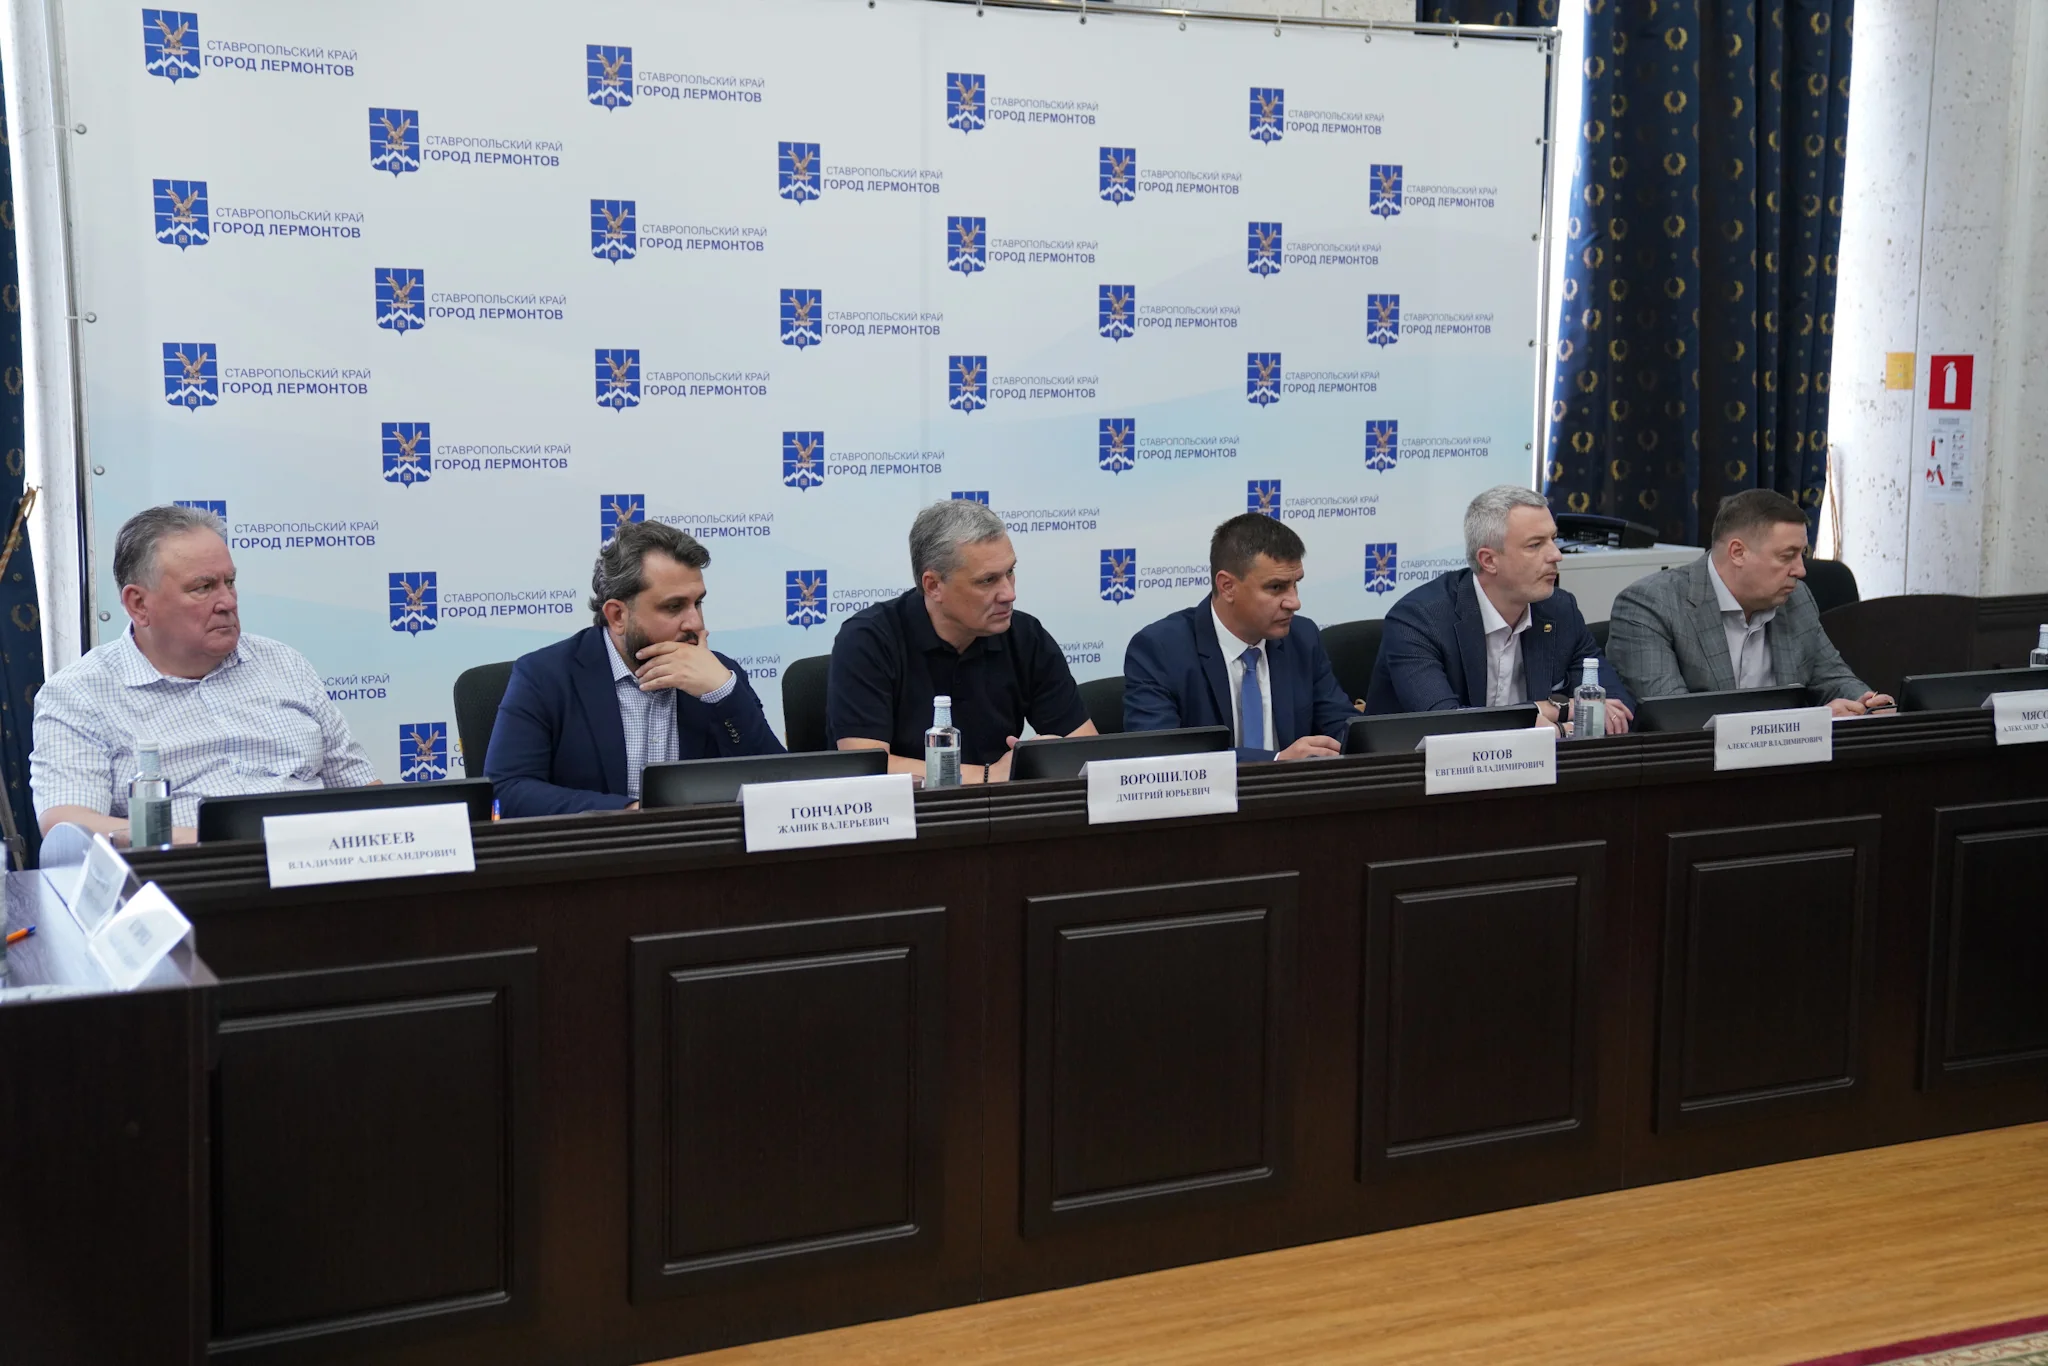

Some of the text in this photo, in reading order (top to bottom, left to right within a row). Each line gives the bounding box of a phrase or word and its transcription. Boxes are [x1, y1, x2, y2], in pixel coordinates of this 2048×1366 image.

[206, 40, 358, 60] СТАВРОПОЛЬСКИЙ КРАЙ
[204, 55, 354, 77] ГОРОД ЛЕРМОНТОВ
[638, 72, 765, 88] СТАВРОПОЛЬСКИЙ КРАЙ
[636, 85, 762, 102] ГОРОД ЛЕРМОНТОВ
[990, 97, 1099, 112] СТАВРОПОЛЬСКИЙ КРАЙ
[988, 109, 1096, 125] ГОРОД ЛЕРМОНТОВ
[1288, 110, 1385, 123] СТАВРОПОЛЬСКИЙ КРАЙ
[1286, 121, 1382, 135] ГОРОД ЛЕРМОНТОВ
[425, 136, 563, 152] СТАВРОПОЛЬСКИЙ КРАЙ
[424, 149, 559, 166] ГОРОД ЛЕРМОНТОВ
[826, 166, 944, 180] СТАВРОПОЛЬСКИЙ КРАЙ
[1140, 170, 1242, 182] СТАВРОПОЛЬСКИЙ КРАЙ
[824, 179, 940, 193] ГОРОД ЛЕРМОНТОВ
[1138, 181, 1239, 194] ГОРОД ЛЕРМОНТОВ
[1406, 184, 1498, 196] СТАВРОПОЛЬСКИЙ КРАЙ
[1404, 196, 1494, 208] ГОРОД ЛЕРМОНТОВ
[215, 208, 365, 222] СТАВРОПОЛЬСКИЙ КРАЙ
[214, 222, 361, 238] ГОРОД ЛЕРМОНТОВ
[641, 224, 768, 237] СТАВРОПОЛЬСКИЙ КРАЙ
[640, 237, 764, 251] ГОРОД ЛЕРМОНТОВ
[990, 238, 1099, 250] СТАВРОПОЛЬСКИЙ КРАЙ
[1286, 242, 1382, 253] СТАВРОПОЛЬСКИЙ КРАЙ
[989, 251, 1095, 263] ГОРОД ЛЕРМОНТОВ
[1284, 254, 1379, 266] ГОРОД ЛЕРМОНТОВ
[431, 293, 567, 305] СТАВРОПОЛЬСКИЙ КРАЙ
[429, 307, 563, 320] ГОРОД ЛЕРМОНТОВ
[827, 311, 944, 322] СТАВРОПОЛЬСКИЙ КРАЙ
[1139, 305, 1241, 315] СТАВРОПОЛЬСКИЙ КРАЙ
[1137, 318, 1237, 329] ГОРОД ЛЕРМОНТОВ
[1403, 312, 1494, 322] СТАВРОПОЛЬСКИЙ КРАЙ
[825, 324, 940, 336] ГОРОД ЛЕРМОНТОВ
[1401, 324, 1491, 335] ГОРОД ЛЕРМОНТОВ
[224, 367, 372, 378] СТАВРОПОЛЬСКИЙ КРАЙ
[645, 371, 770, 382] СТАВРОПОЛЬСКИЙ КРАЙ
[1284, 369, 1381, 380] СТАВРОПОЛЬСКИЙ КРАЙ
[991, 375, 1099, 385] СТАВРОПОЛЬСКИЙ КРАЙ
[222, 382, 368, 396] ГОРОД ЛЕРМОНТОВ
[644, 385, 767, 397] ГОРОД ЛЕРМОНТОВ
[990, 388, 1096, 400] ГОРОД ЛЕРМОНТОВ
[1283, 383, 1377, 394] ГОРОД ЛЕРМОНТОВ
[1139, 435, 1240, 446] СТАВРОПОЛЬСКИЙ КРАЙ
[1401, 434, 1492, 446] СТАВРОПОЛЬСКИЙ КРАЙ
[437, 444, 571, 455] СТАВРОПОЛЬСКИЙ КРАЙ
[829, 450, 945, 461] СТАВРОПОЛЬСКИЙ КРАЙ
[1137, 448, 1236, 460] ГОРОД ЛЕРМОНТОВ
[1399, 448, 1488, 460] ГОРОД ЛЕРМОНТОВ
[435, 458, 568, 471] ГОРОД ЛЕРМОНТОВ
[827, 464, 942, 476] ГОРОД ЛЕРМОНТОВ
[1284, 493, 1380, 507] СТАВРОПОЛЬСКИЙ КРАЙ
[749, 511, 774, 522] КРАЙ
[1078, 506, 1101, 516] КРАЙ
[1283, 507, 1376, 519] ГОРОД ЛЕРМОНТОВ
[234, 519, 379, 533] СТАВРОПОЛЬСКИЙ КРАЙ
[694, 525, 771, 538] ЛЕРМОНТОВ
[1005, 520, 1097, 534] РОД ЛЕРМОНТОВ
[232, 535, 375, 550] ГОРОД ЛЕРМОНТОВ
[1138, 576, 1211, 589] ГОРОД ЛЕРМО
[1398, 571, 1429, 581] ГОРОД
[443, 588, 577, 603] СТАВРОПОЛЬСКИЙ КРАЙ
[441, 603, 573, 618] ГОРОД ЛЕРМОНТОВ
[1082, 639, 1104, 650] КРАЙ
[755, 653, 781, 665] КРАЙ
[1065, 653, 1101, 664] ОНТОВ
[361, 672, 390, 685] КРАЙ
[326, 688, 387, 701] МОНТОВ
[1750, 722, 1801, 735] РЯБИКИН
[2003, 723, 2039, 732] АЛЕКСАНДР
[1727, 735, 1823, 750] АЛЕКСАНДР ВЛАДИМИРОВИЧ
[1472, 748, 1513, 762] КОТОВ
[1435, 760, 1545, 777] ЕВГЕНИЙ ВЛАДИМИРОВИЧ
[1120, 769, 1207, 786] ВОРОШИЛОВ
[1116, 787, 1210, 803] ДМИТРИЙ ЮРЬЕВИЧ
[791, 801, 873, 819] ГОНЧАРОВ
[777, 817, 889, 834] ЖАНИК ВАЛЕРЬЕВИЧ
[329, 831, 416, 850] АНИКЕЕВ
[288, 848, 457, 870] ВЛАДИМИР АЛЕКСАНДРОВИЧ
